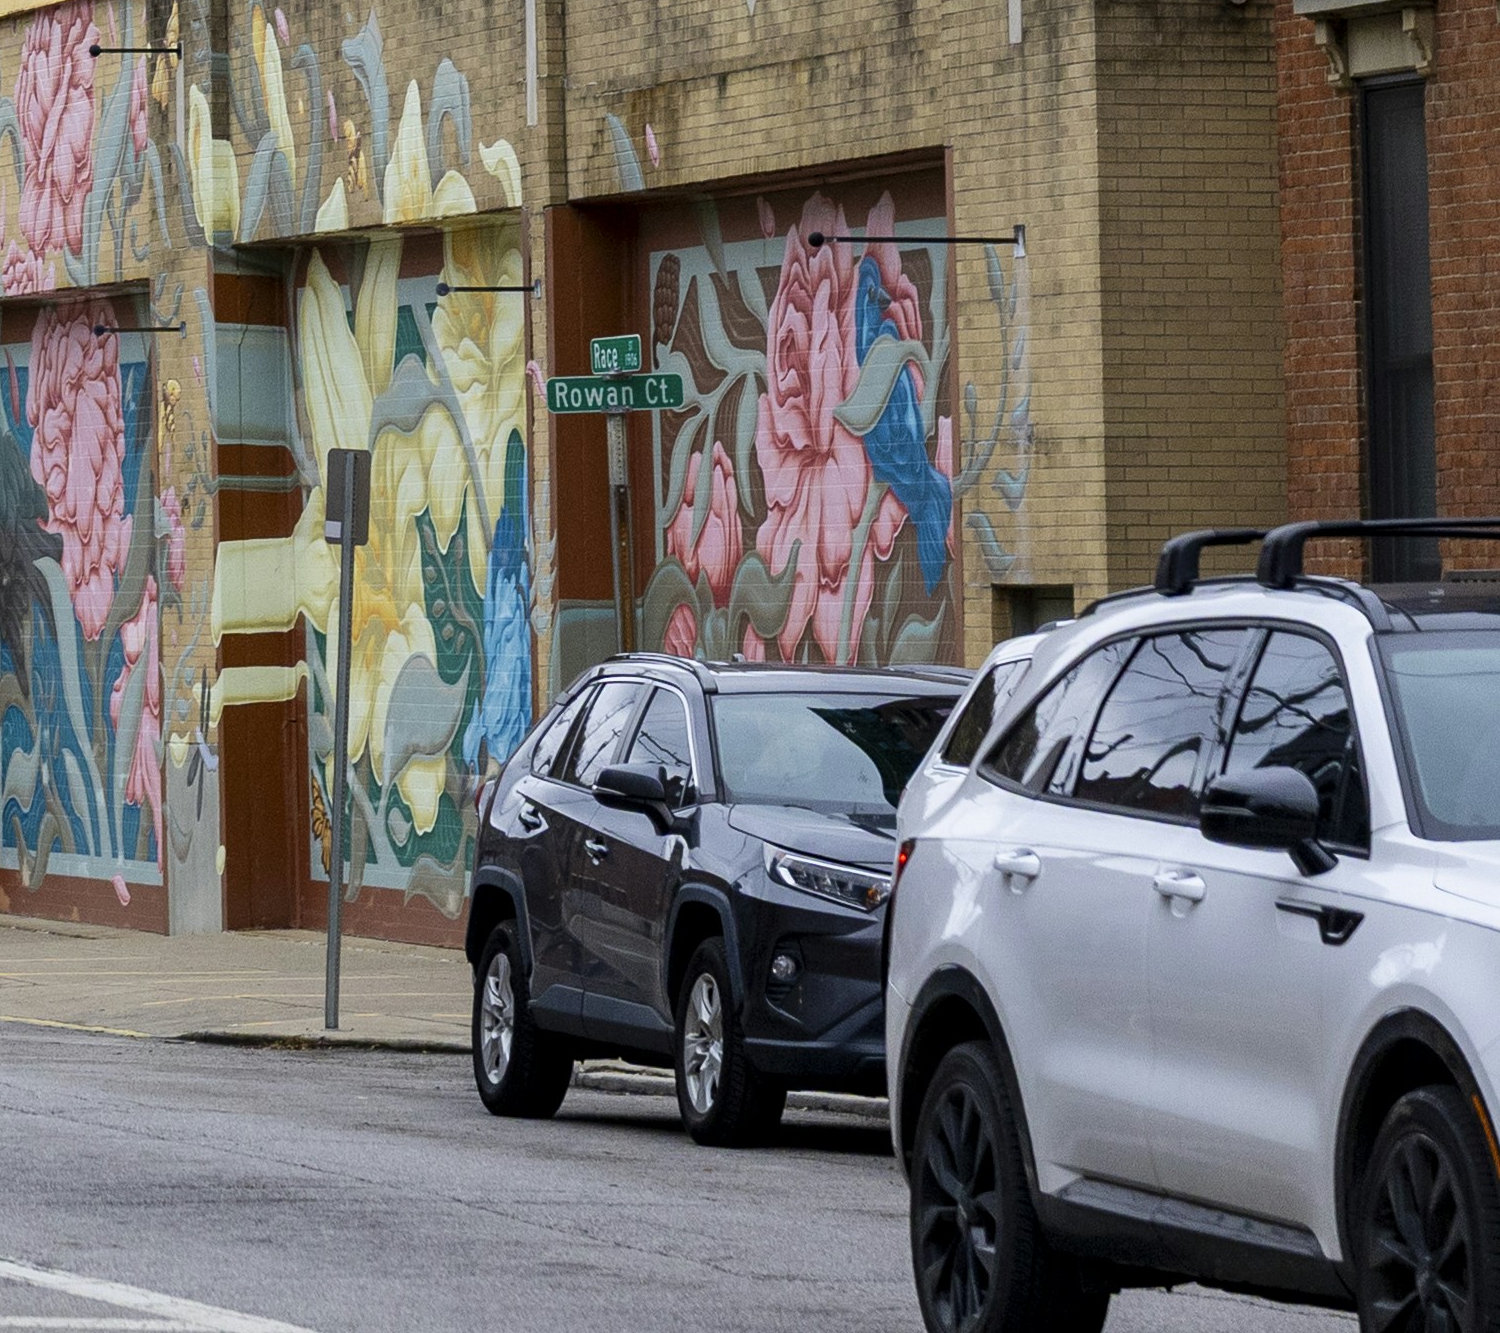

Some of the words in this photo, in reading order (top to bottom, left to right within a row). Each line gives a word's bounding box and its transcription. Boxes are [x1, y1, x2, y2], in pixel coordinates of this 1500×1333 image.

[593, 343, 619, 368] Race
[555, 382, 634, 408] Rowan
[645, 377, 674, 405] Ct.
